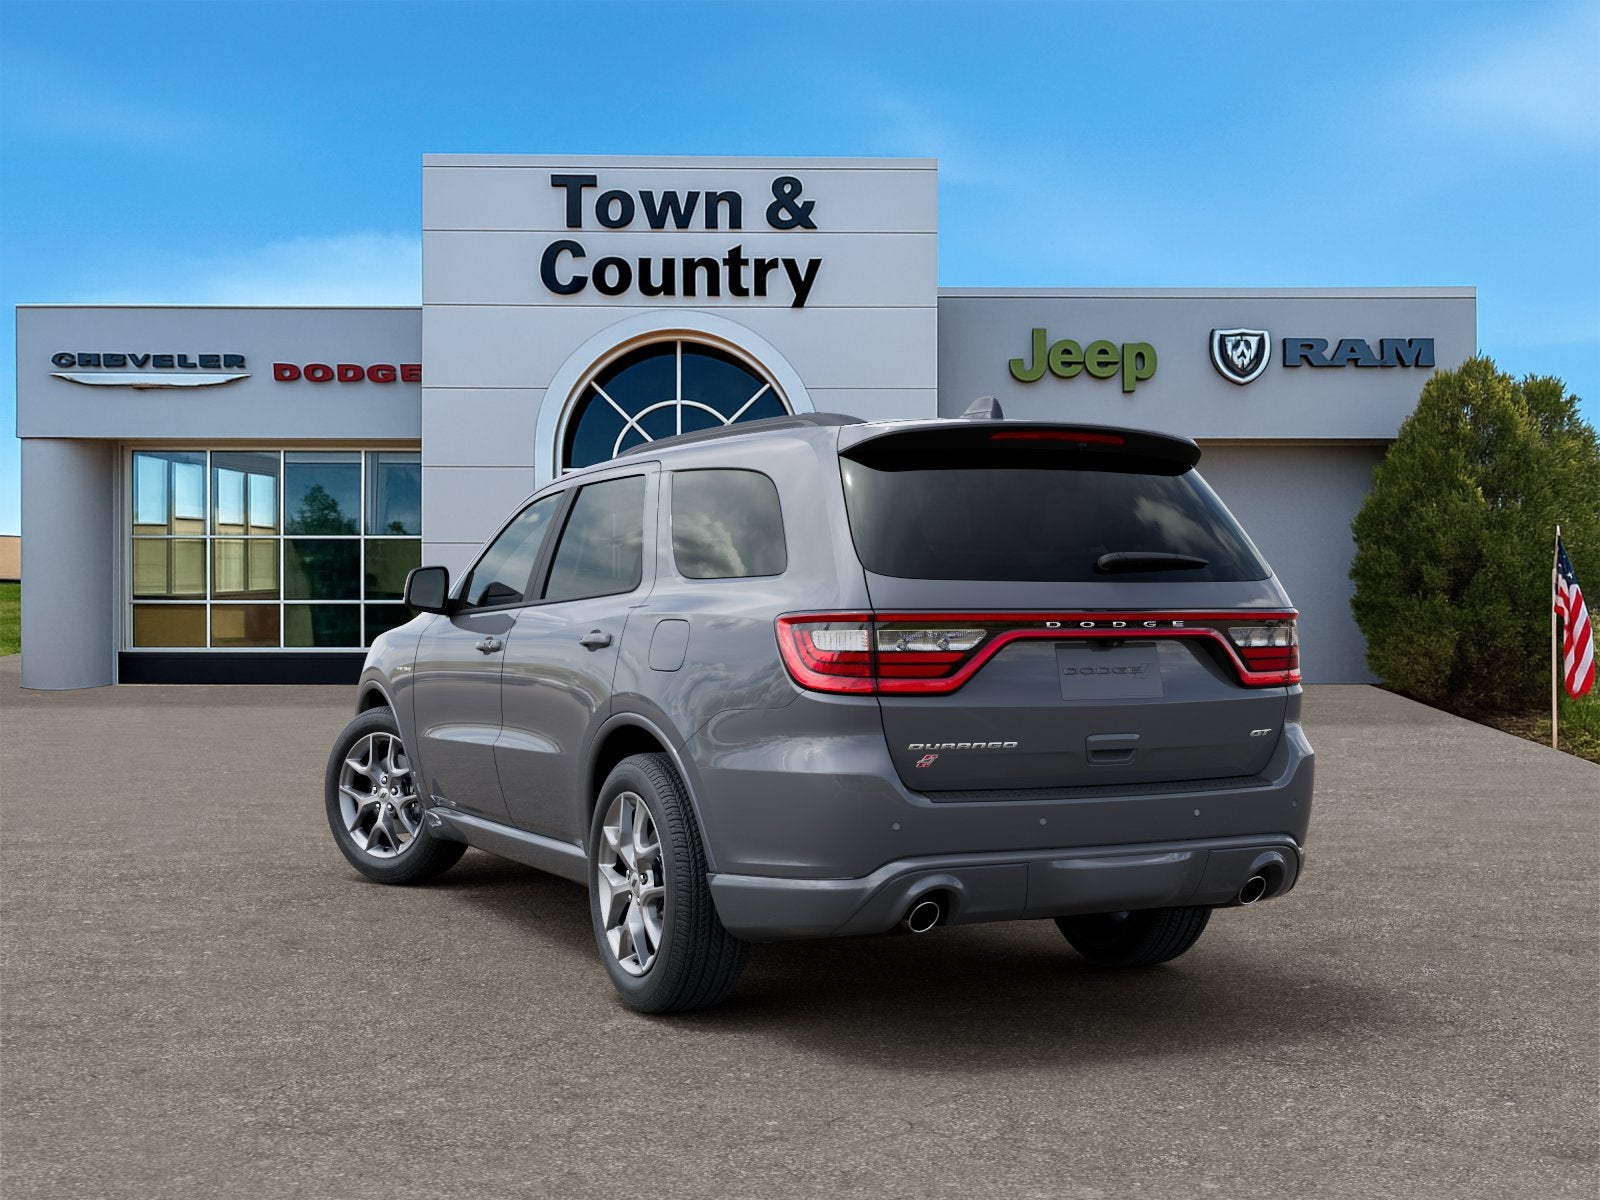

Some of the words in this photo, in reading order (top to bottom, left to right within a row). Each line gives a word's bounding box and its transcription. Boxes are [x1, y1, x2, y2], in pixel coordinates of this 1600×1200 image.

[550, 174, 742, 229] Town
[765, 176, 818, 230] &
[540, 239, 822, 308] Country
[1009, 328, 1157, 393] Jeep
[1282, 337, 1435, 368] RAM
[273, 363, 422, 383] DODGE
[1045, 620, 1185, 629] DODGE
[1250, 728, 1272, 737] GT
[908, 741, 1019, 751] DURANGO
